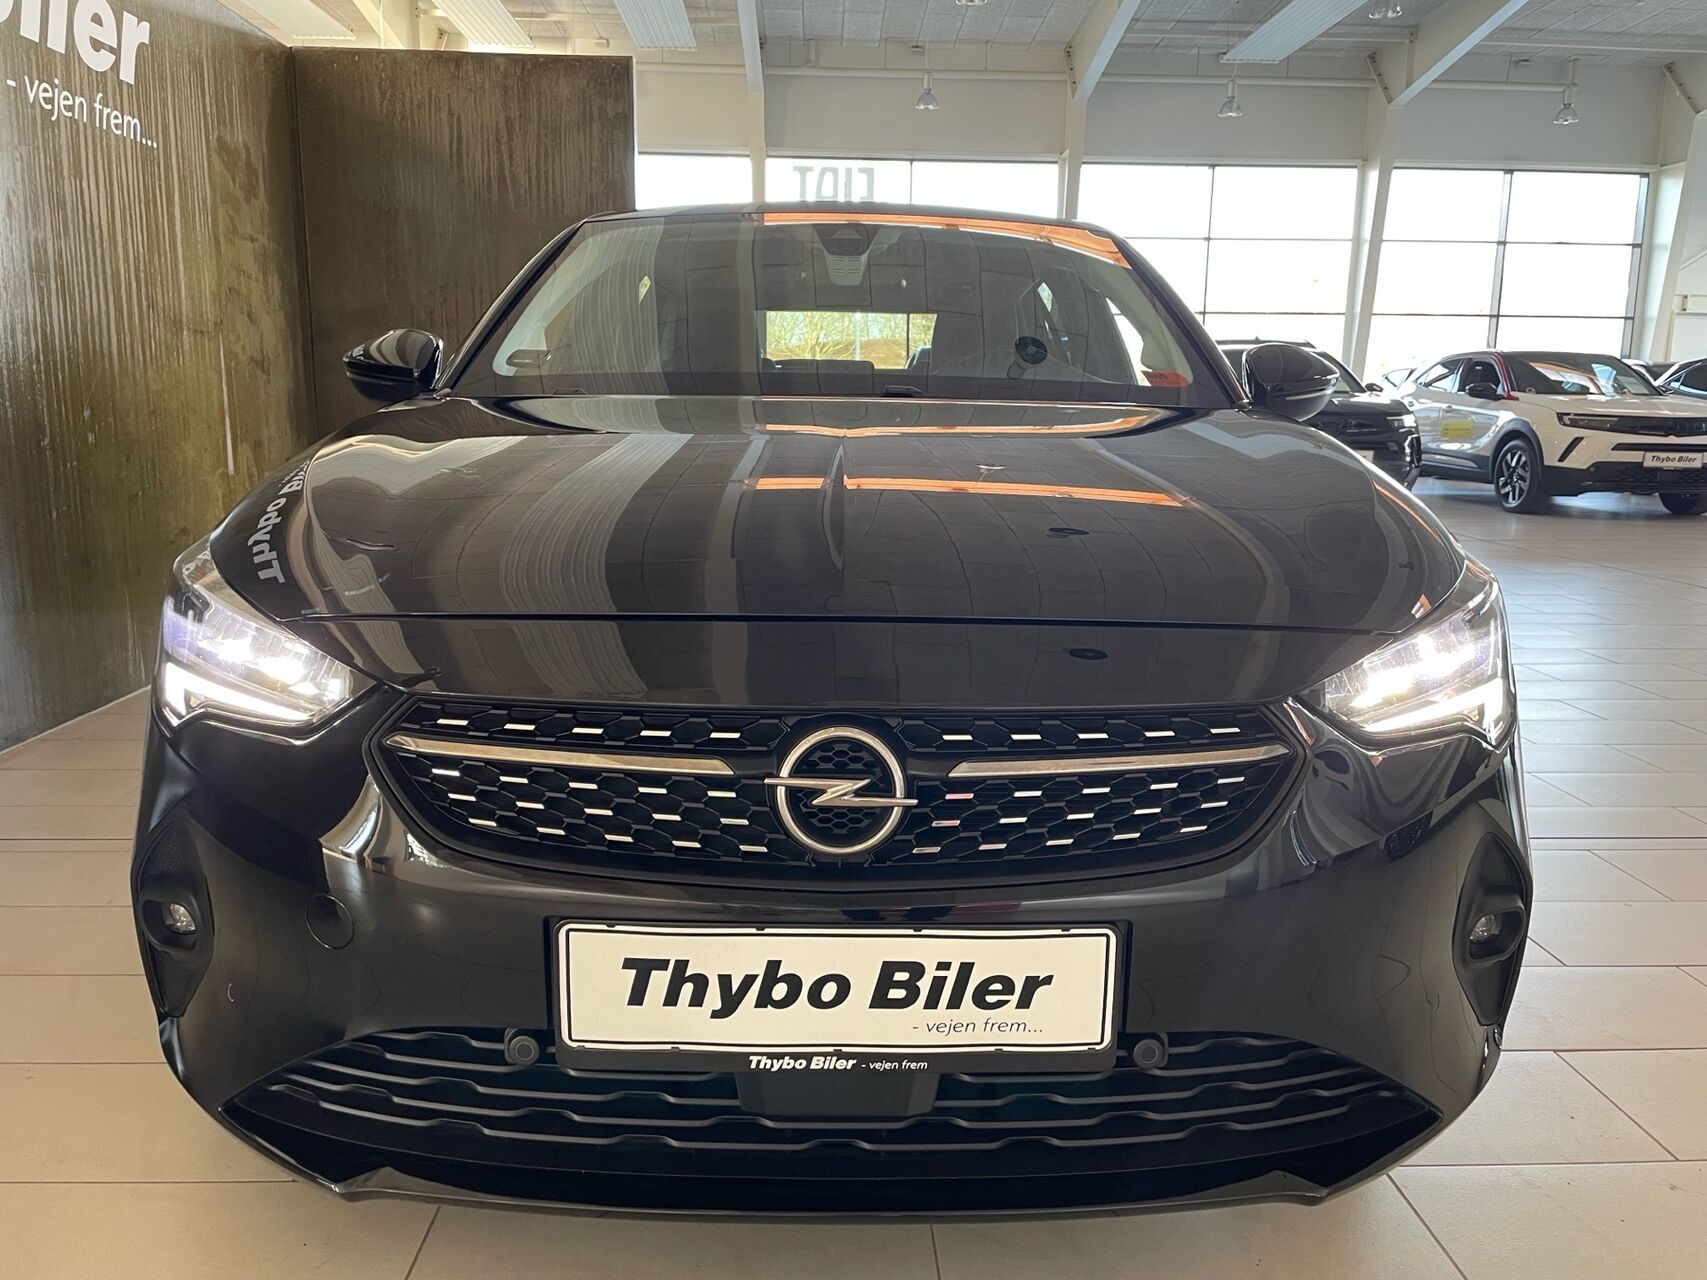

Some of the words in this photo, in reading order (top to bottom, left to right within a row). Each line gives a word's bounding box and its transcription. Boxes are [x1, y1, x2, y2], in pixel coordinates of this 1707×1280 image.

[0, 0, 150, 85] ler
[24, 75, 87, 123] vejen
[93, 92, 158, 149] frem...
[1651, 455, 1677, 463] Thybo
[1677, 455, 1697, 463] Biler
[620, 957, 852, 1019] Thybo
[868, 960, 1055, 1010] Biler
[926, 1018, 976, 1037] vejen
[983, 1017, 1043, 1033] frem...
[748, 1055, 807, 1072] Thybo
[809, 1056, 857, 1071] Biler
[869, 1060, 899, 1072] vejen
[901, 1059, 928, 1070] frem
